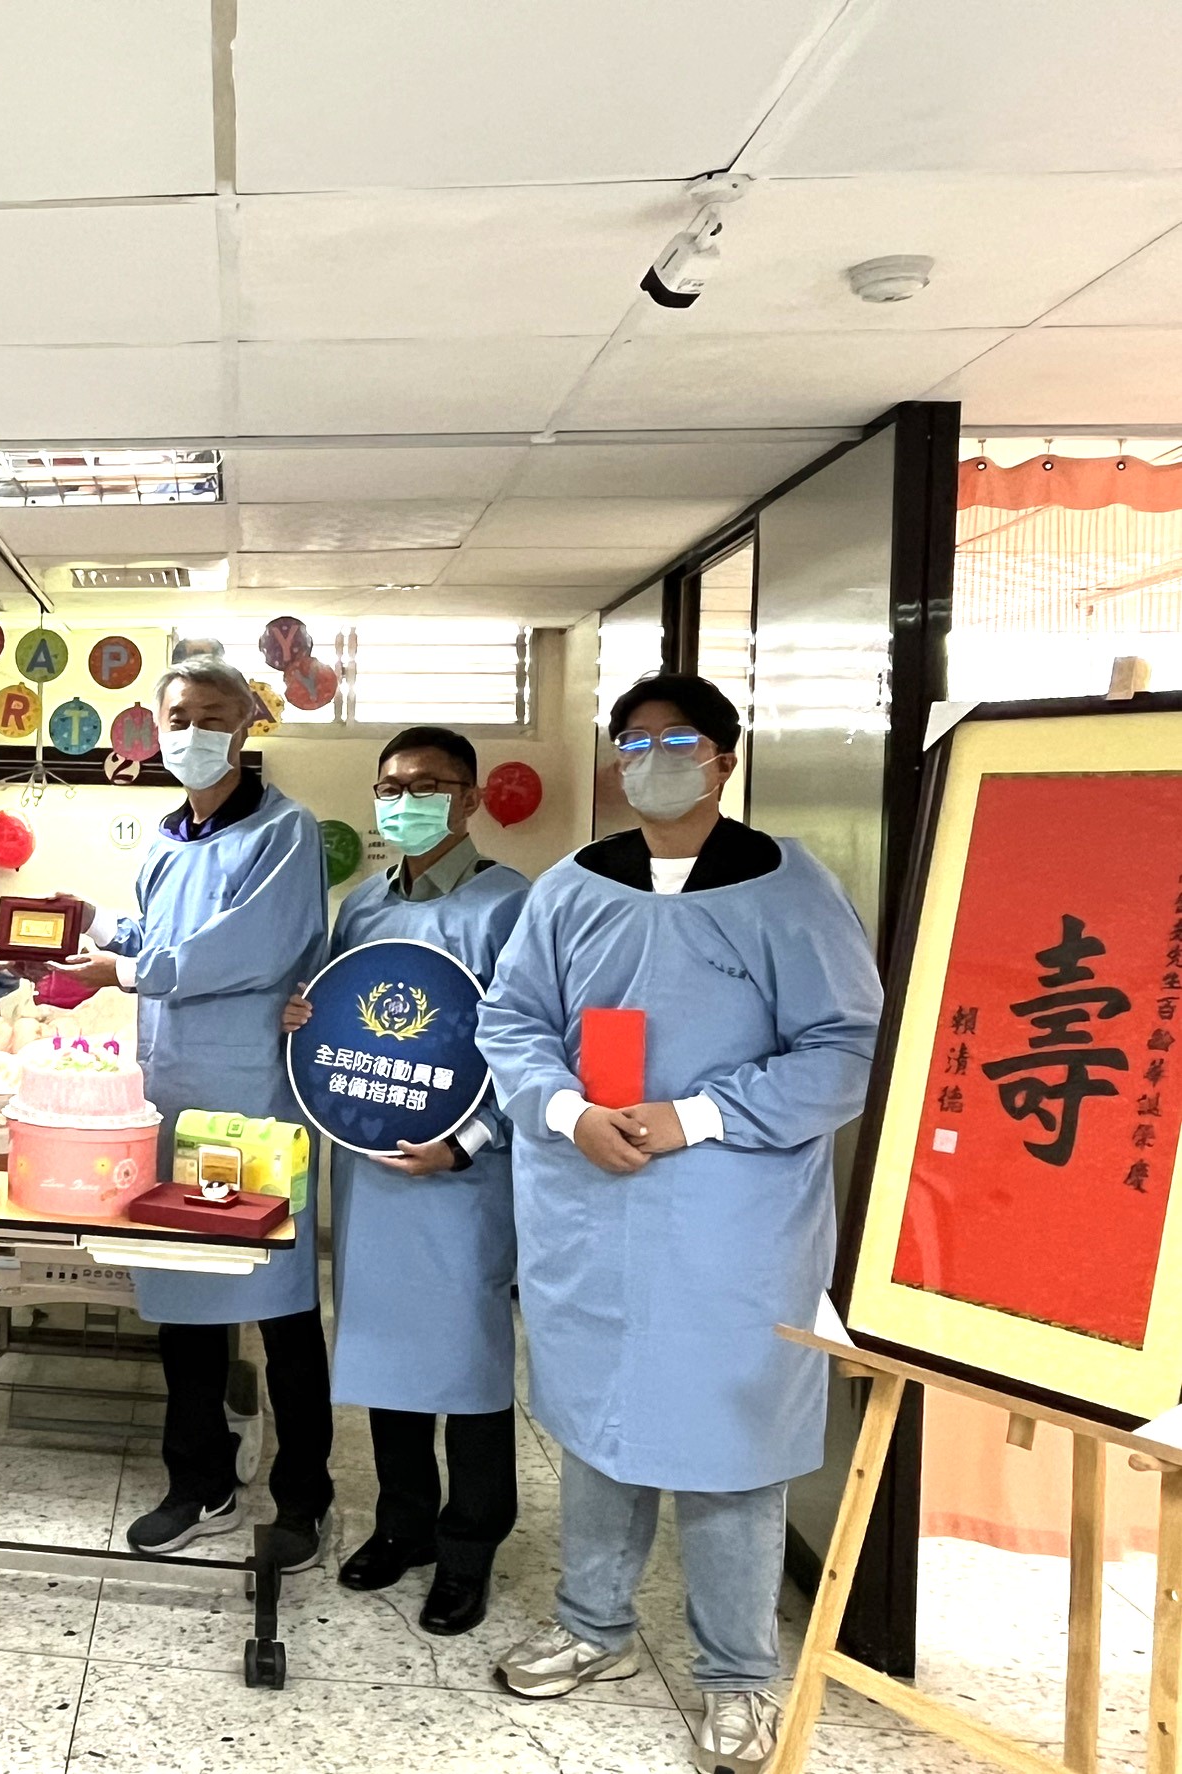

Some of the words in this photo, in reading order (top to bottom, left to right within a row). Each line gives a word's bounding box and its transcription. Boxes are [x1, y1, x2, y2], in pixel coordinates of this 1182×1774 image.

[115, 821, 136, 840] 11
[937, 1005, 979, 1114] 賴清德
[981, 914, 1130, 1168] 壽
[314, 1043, 455, 1091] 全民防衛動員署
[329, 1072, 429, 1112] 後備指揮部
